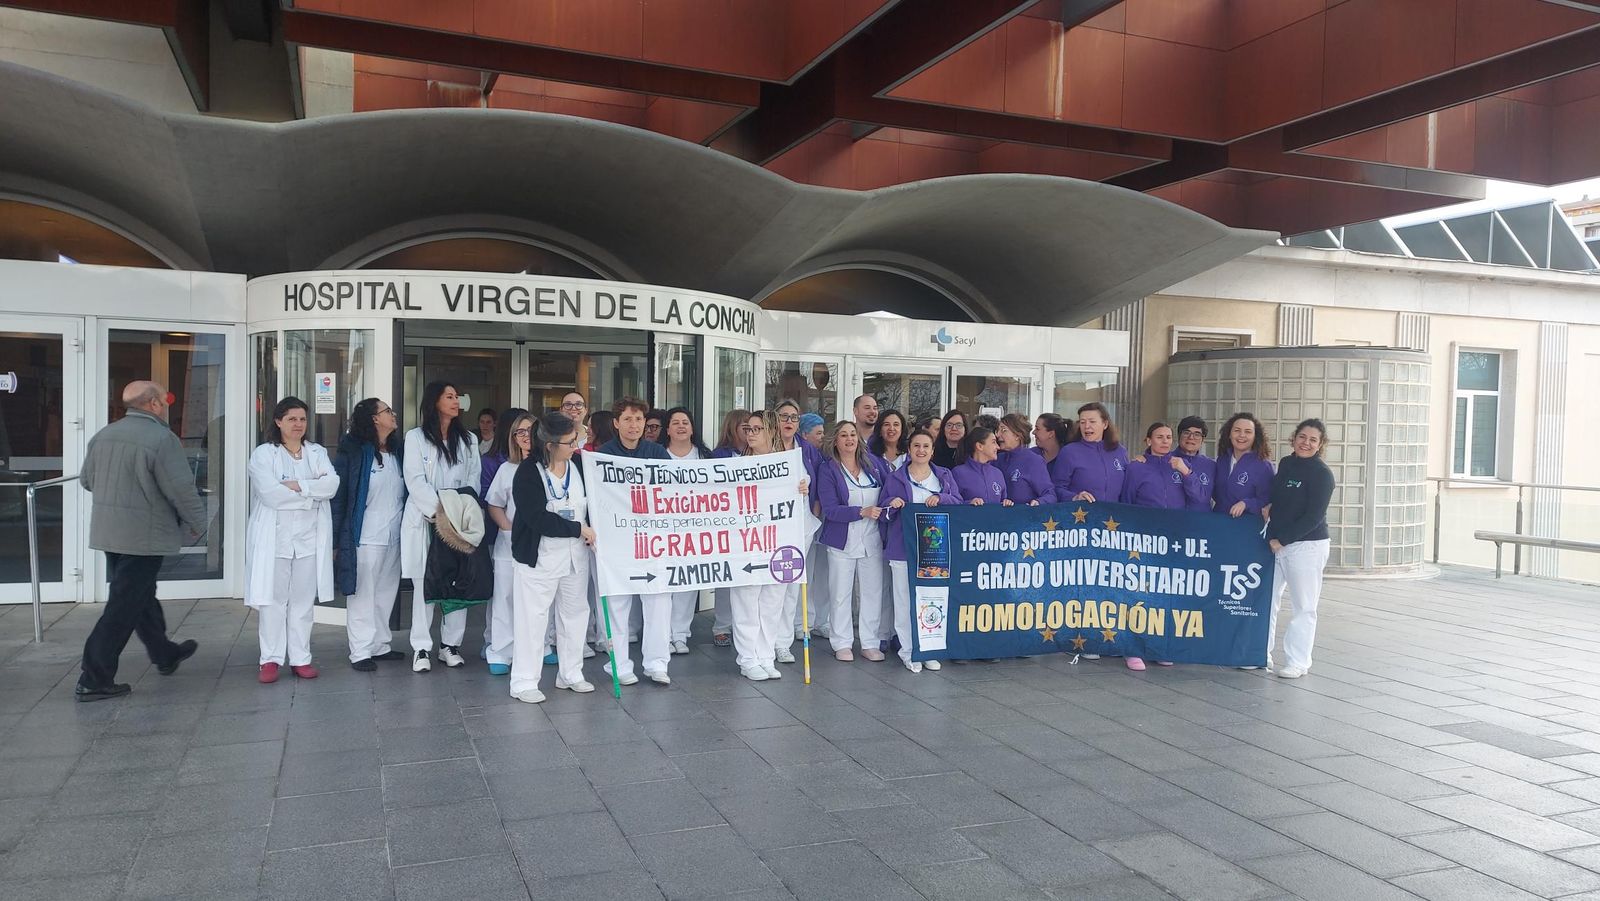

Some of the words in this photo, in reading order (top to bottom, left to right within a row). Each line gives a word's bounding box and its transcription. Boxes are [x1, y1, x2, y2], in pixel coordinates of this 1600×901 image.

[284, 281, 422, 312] HOSPITAL
[441, 283, 581, 318] VIRGEN
[595, 291, 638, 322] DE
[650, 296, 682, 326] LA
[689, 301, 756, 336] CONCHA
[954, 335, 976, 347] Sacyl
[630, 518, 648, 533] que
[650, 518, 669, 529] nos
[673, 516, 737, 532] pertenece
[744, 513, 765, 528] por
[769, 500, 795, 521] LEY
[960, 529, 1019, 551] TÉCNICO
[1021, 528, 1088, 551] SUPERIOR
[1090, 528, 1169, 556] SANITARIO
[1185, 538, 1212, 558] U.E.
[666, 561, 733, 586] ZAMORA
[779, 561, 794, 570] TSS
[977, 561, 1045, 590] GRADO
[1049, 558, 1210, 597] UNIVERSITARIO
[1220, 562, 1263, 600] TSS
[958, 600, 1166, 637] HOMOLOGACIÓN
[1171, 609, 1204, 638] YA
